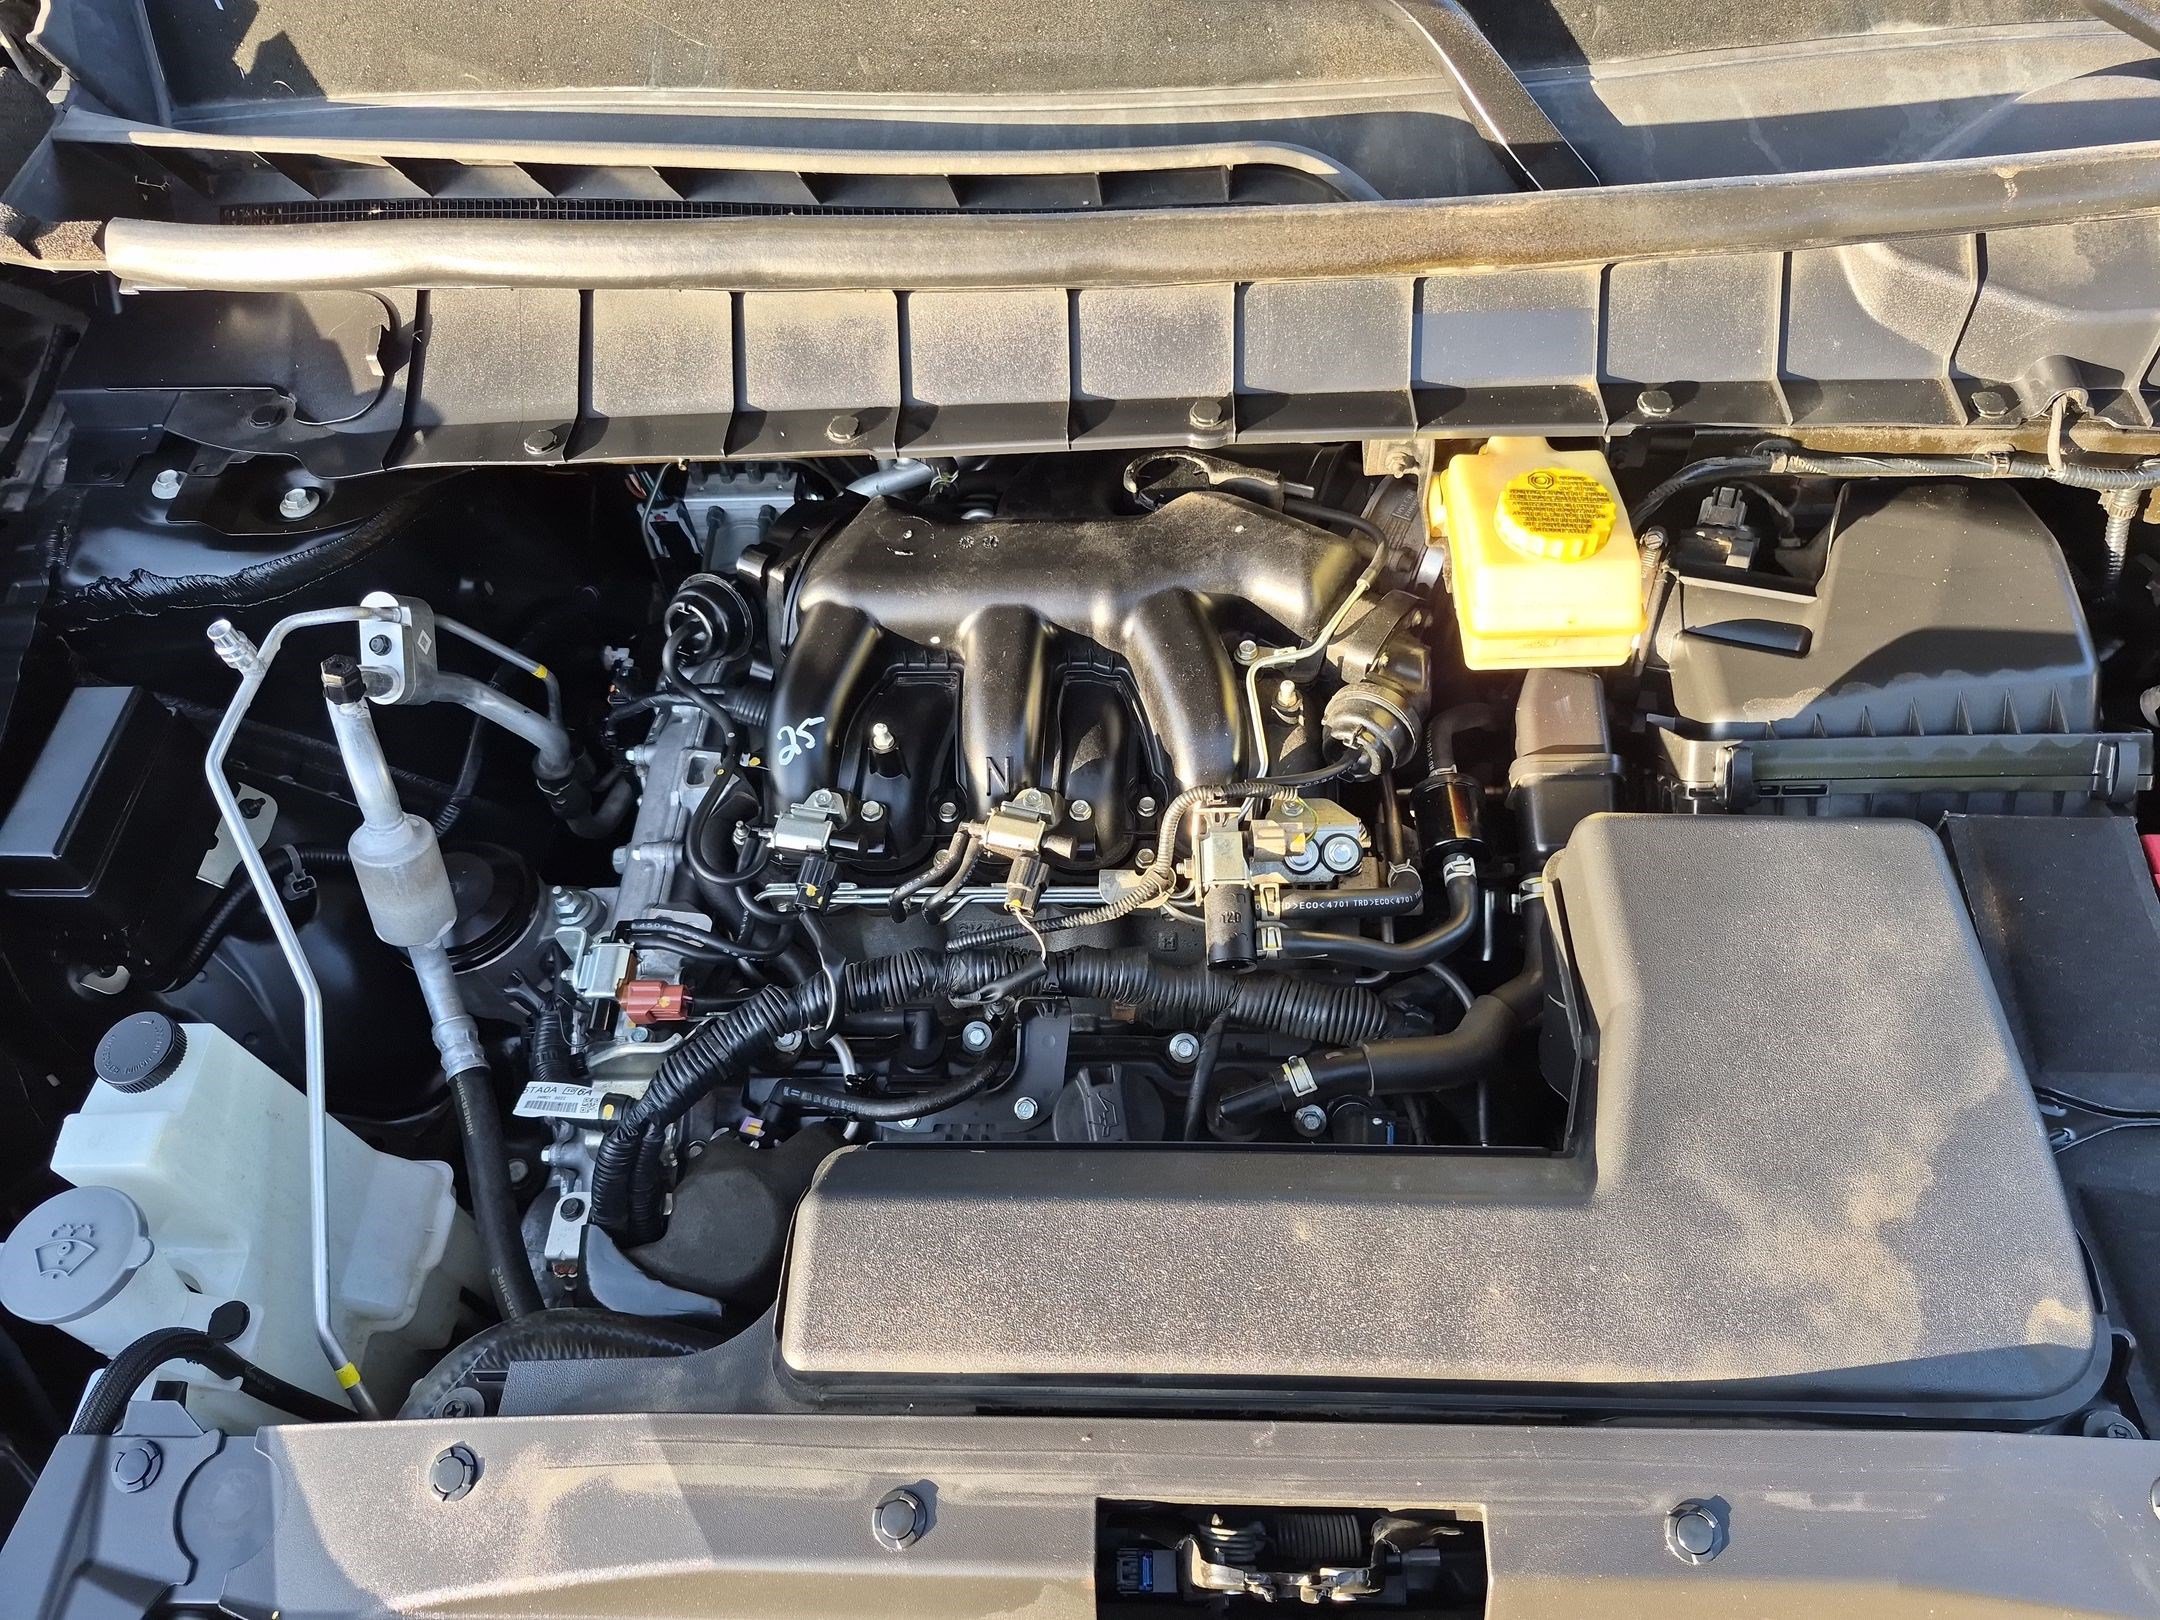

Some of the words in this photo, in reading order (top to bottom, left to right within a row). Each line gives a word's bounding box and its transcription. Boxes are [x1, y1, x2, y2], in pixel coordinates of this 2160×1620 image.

[776, 716, 826, 766] 25
[985, 757, 1012, 797] N
[1353, 896, 1413, 908] TRD>ECO<4701
